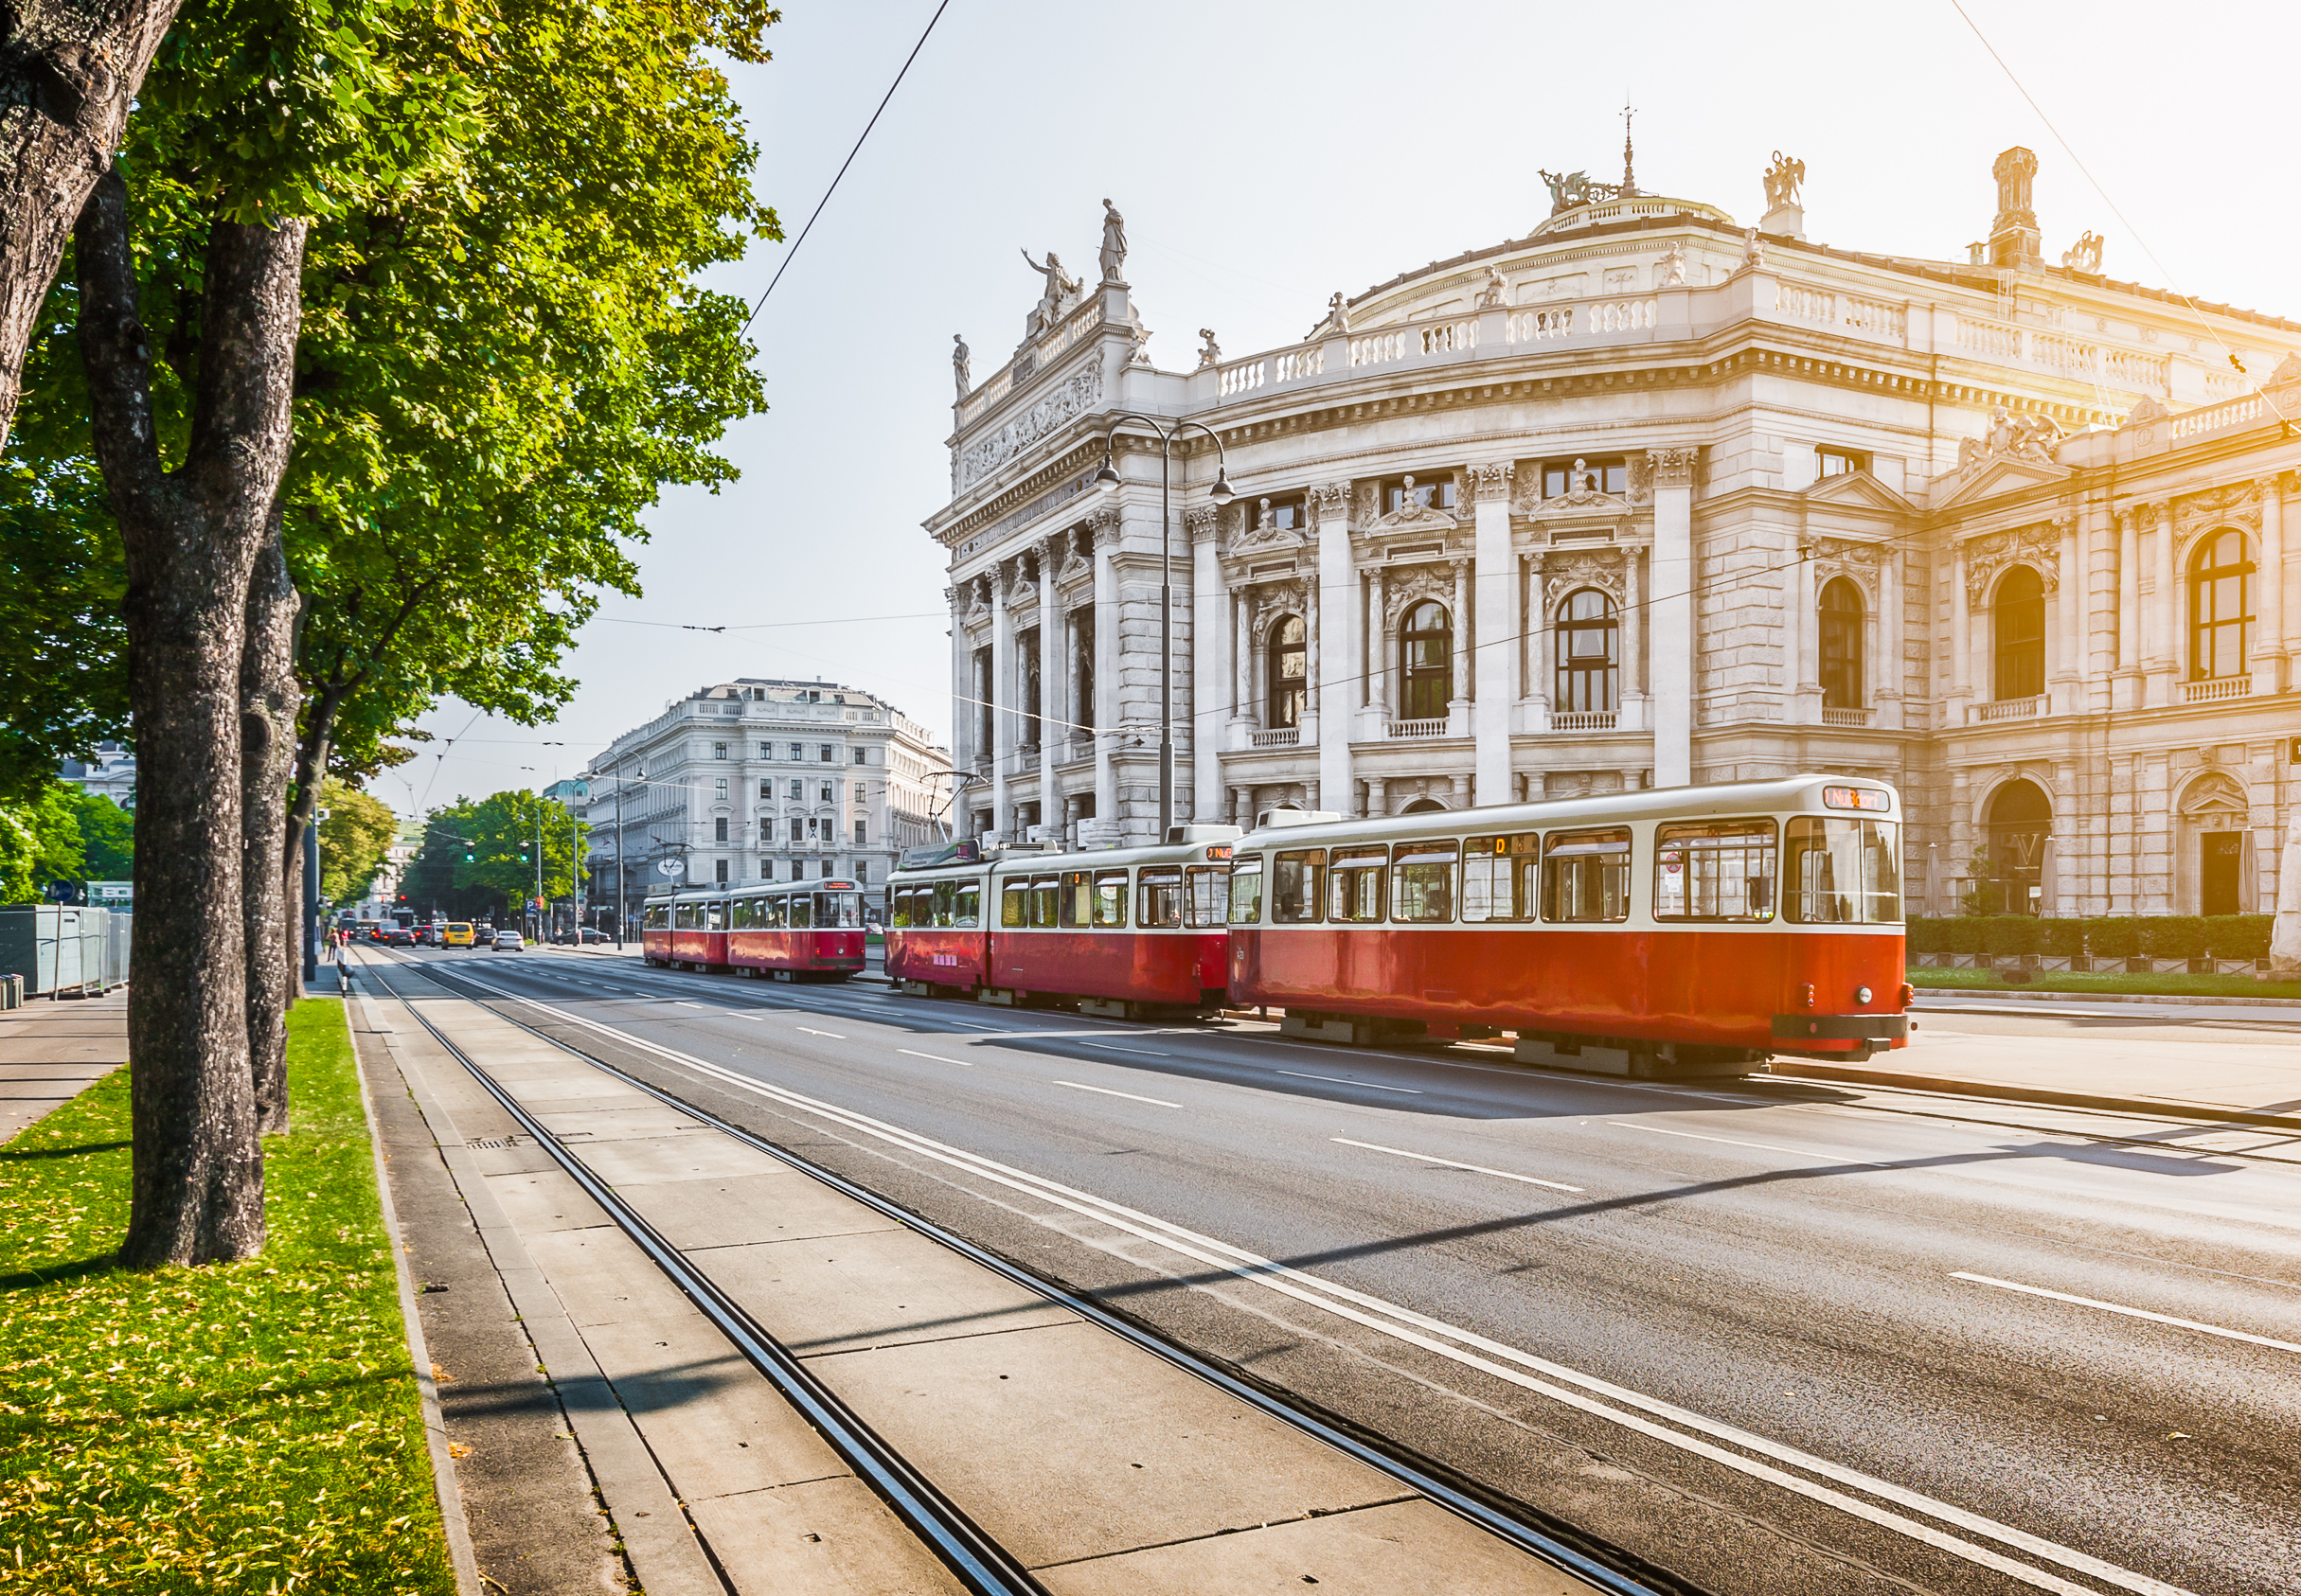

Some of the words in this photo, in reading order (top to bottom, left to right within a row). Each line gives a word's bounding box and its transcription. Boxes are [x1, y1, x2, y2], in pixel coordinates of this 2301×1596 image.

[1832, 789, 1880, 807] Nußdorf
[1496, 839, 1505, 853] D
[2014, 834, 2040, 865] V
[526, 900, 534, 909] P
